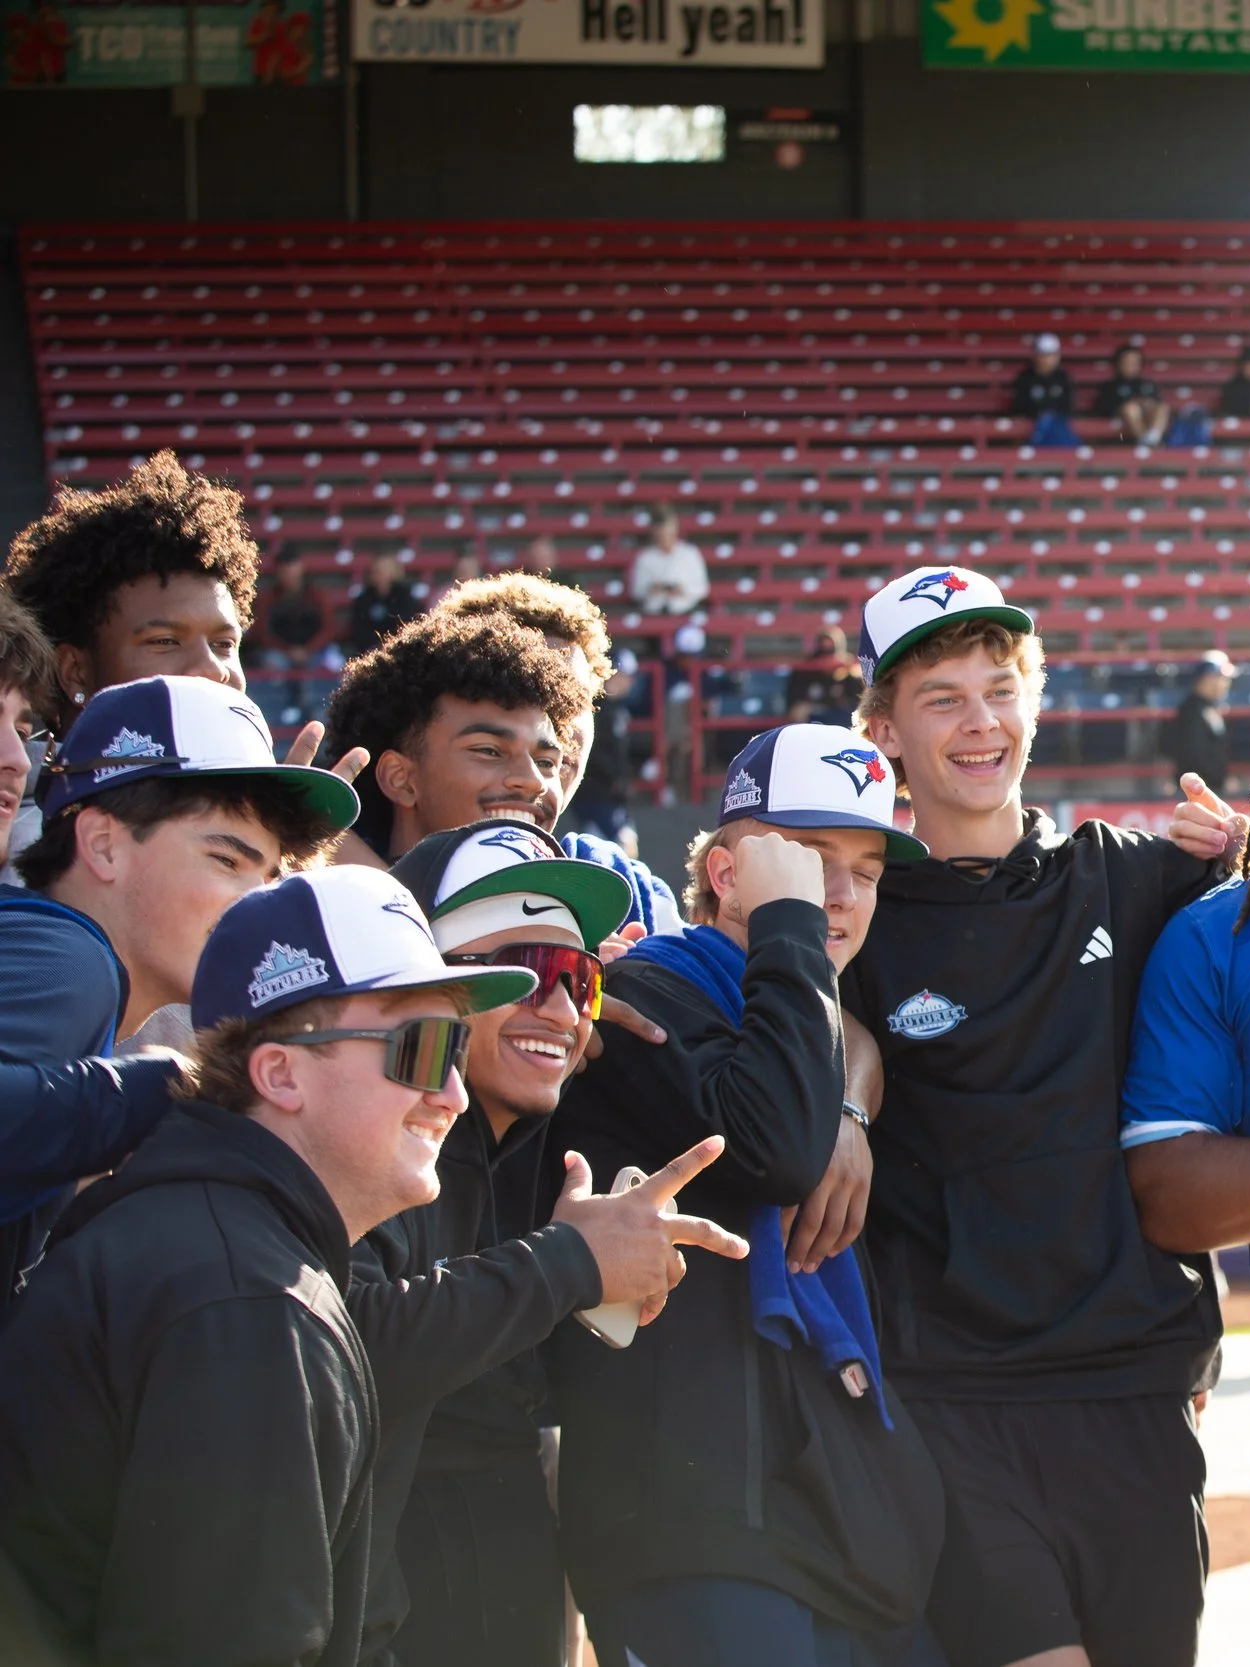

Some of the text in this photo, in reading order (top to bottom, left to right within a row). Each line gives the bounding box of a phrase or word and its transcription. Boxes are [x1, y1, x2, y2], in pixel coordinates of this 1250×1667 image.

[371, 17, 522, 53] COUNTRY
[581, 0, 807, 58] Hell yeah!
[255, 965, 320, 1001] FUTURES
[894, 1009, 961, 1029] FUTURES
